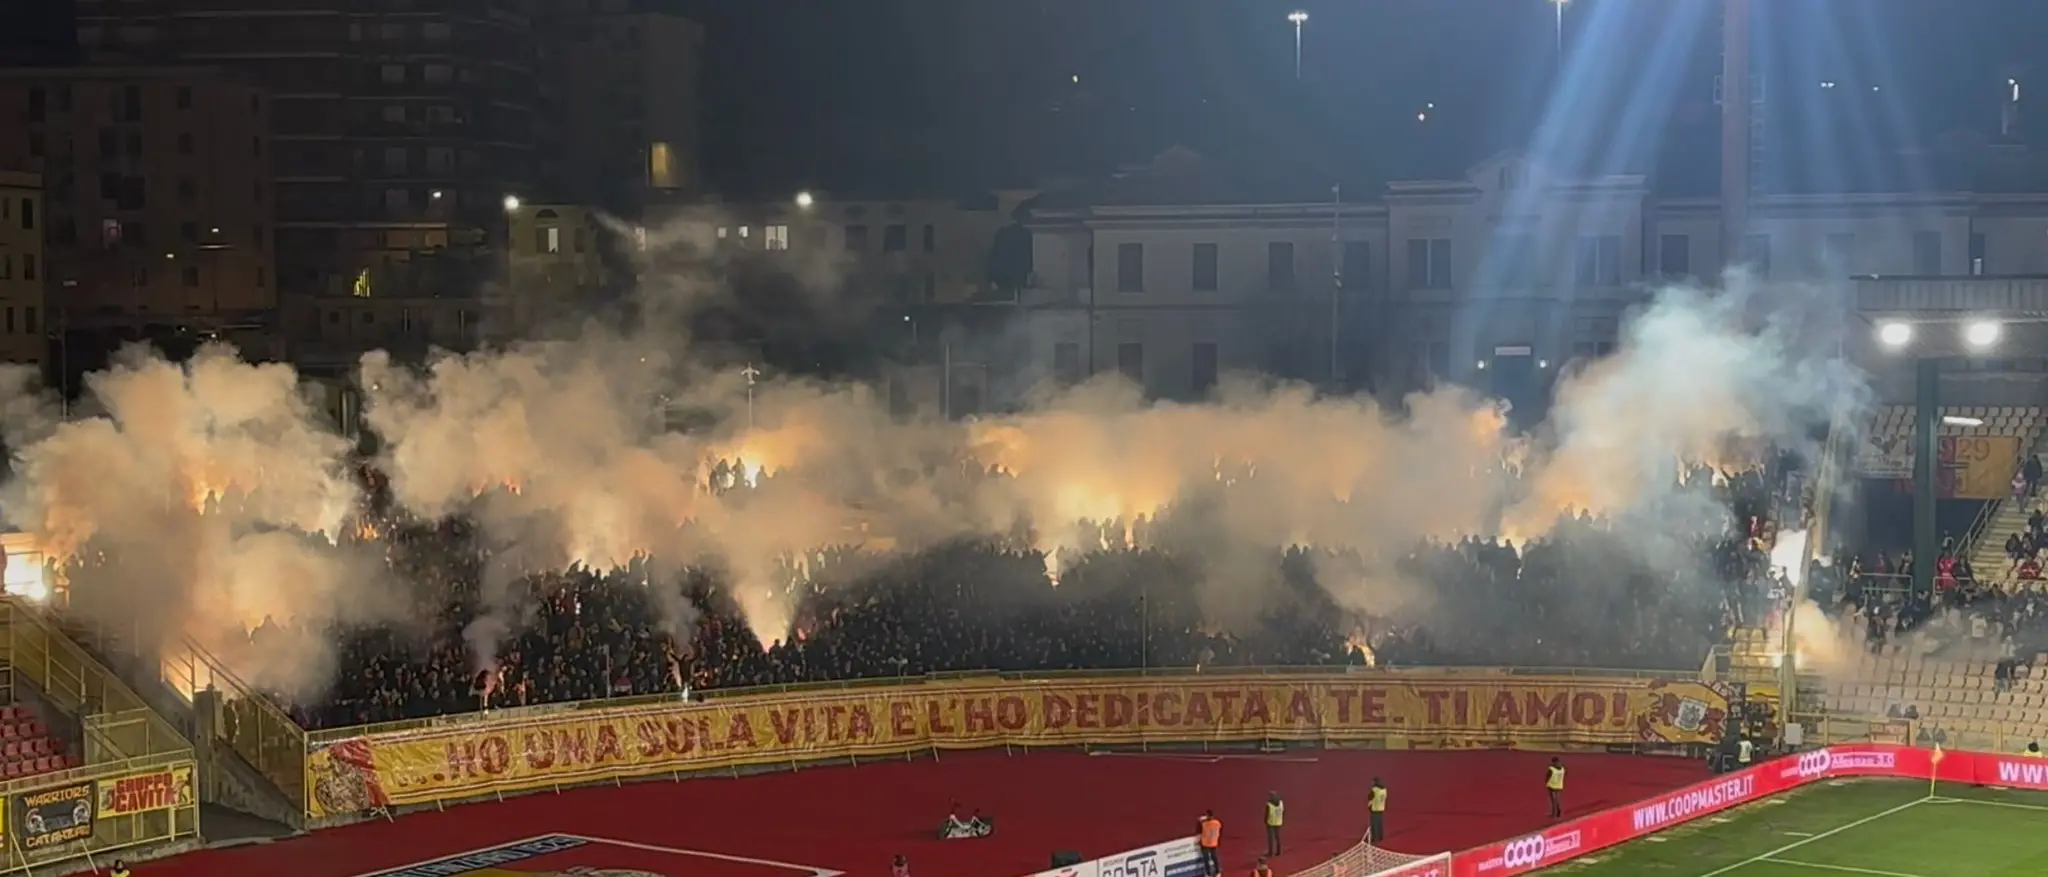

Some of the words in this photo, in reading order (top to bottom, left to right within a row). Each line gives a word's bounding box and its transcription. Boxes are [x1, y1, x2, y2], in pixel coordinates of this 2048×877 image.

[524, 725, 623, 769] UNA
[636, 713, 757, 757] SOLA
[770, 704, 874, 744] VITA
[890, 700, 916, 738] E
[928, 697, 1027, 734] L'HO
[1042, 691, 1270, 728] DEDICATA
[1284, 691, 1316, 724] A
[1329, 690, 1405, 724] TE.
[1418, 690, 1468, 726] TI
[1486, 690, 1629, 727] AMO!
[115, 773, 173, 794] GRUPPO
[1998, 760, 2048, 784] WW
[25, 785, 90, 809] WARRIORS
[1633, 775, 1754, 831] WWW.COOPMASTER.IT
[1504, 833, 1546, 868] coop
